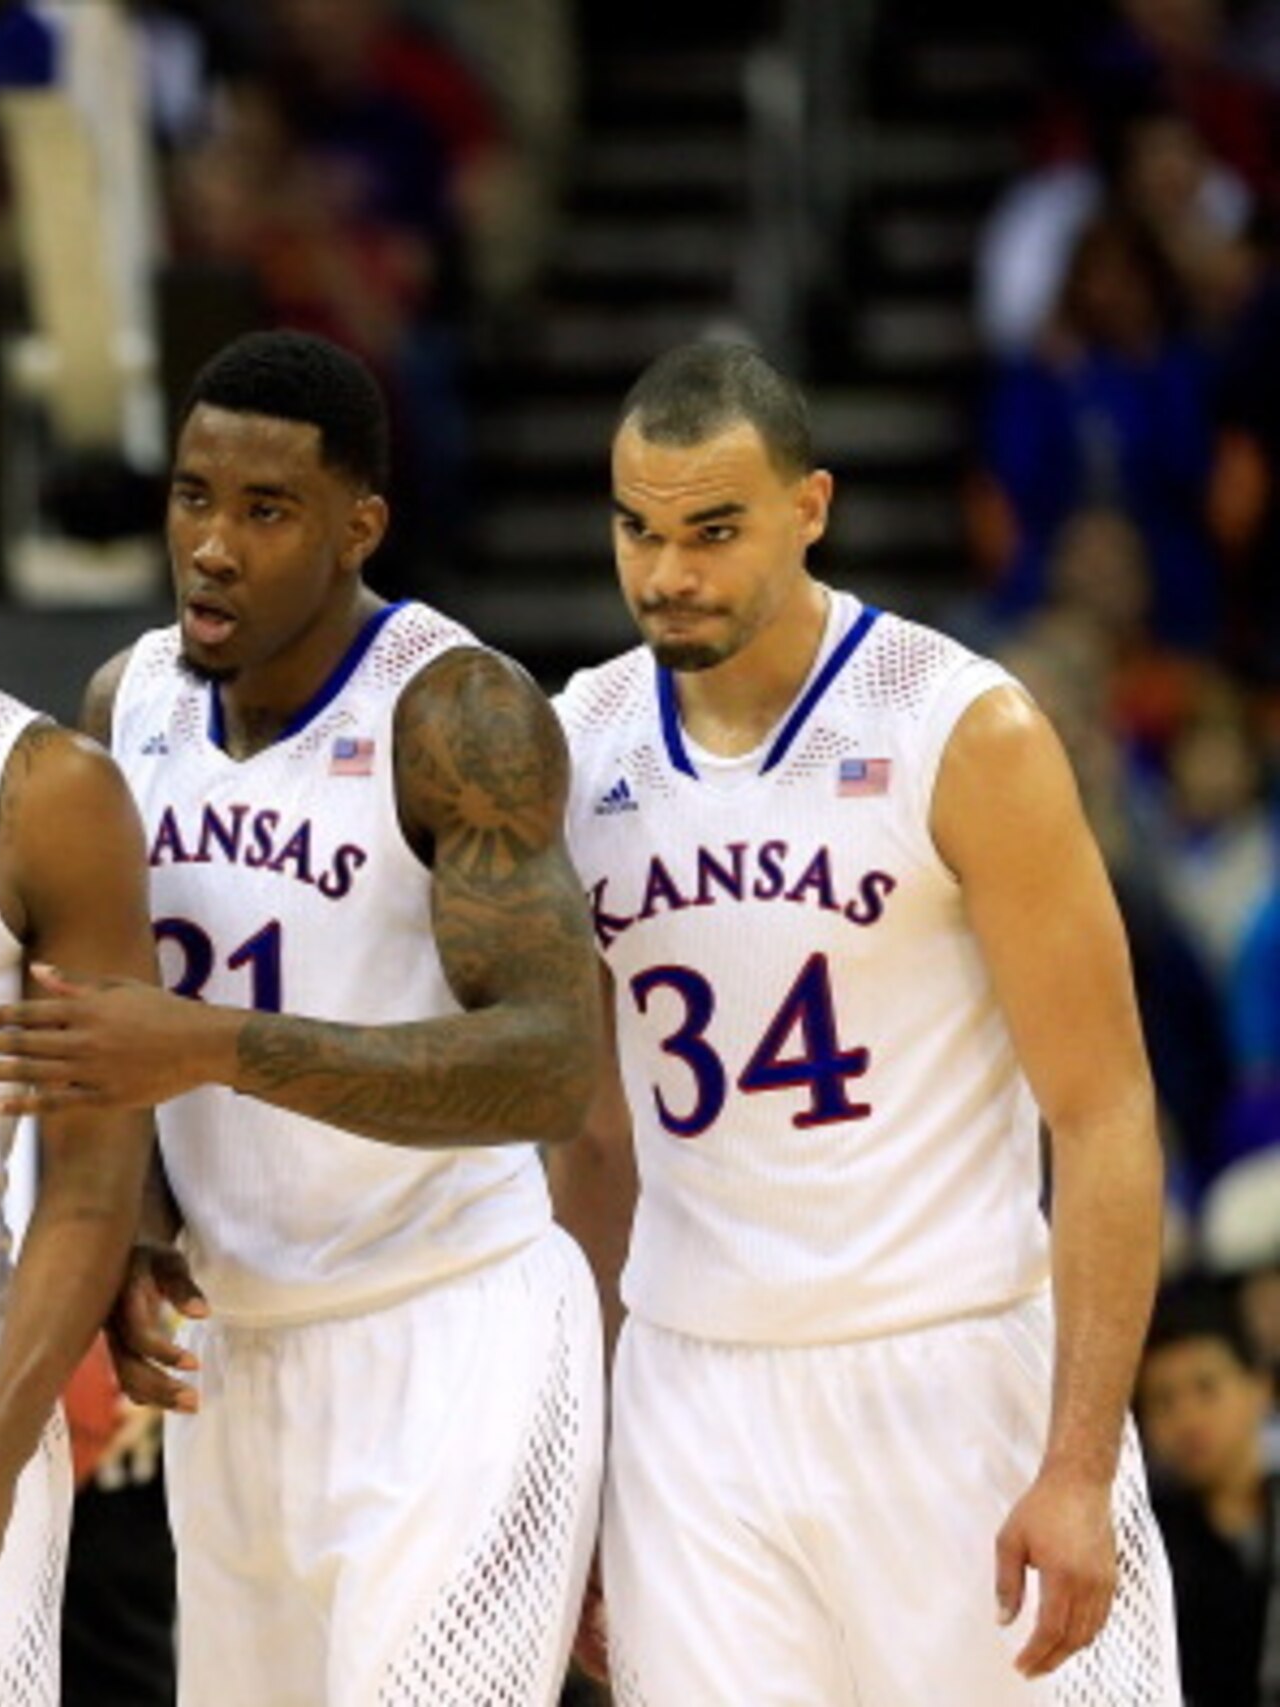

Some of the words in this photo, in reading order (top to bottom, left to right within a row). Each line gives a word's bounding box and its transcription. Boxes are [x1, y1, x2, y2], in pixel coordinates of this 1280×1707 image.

[148, 803, 367, 900] ANSAS
[586, 840, 897, 950] KANSAS
[629, 951, 872, 1139] 34
